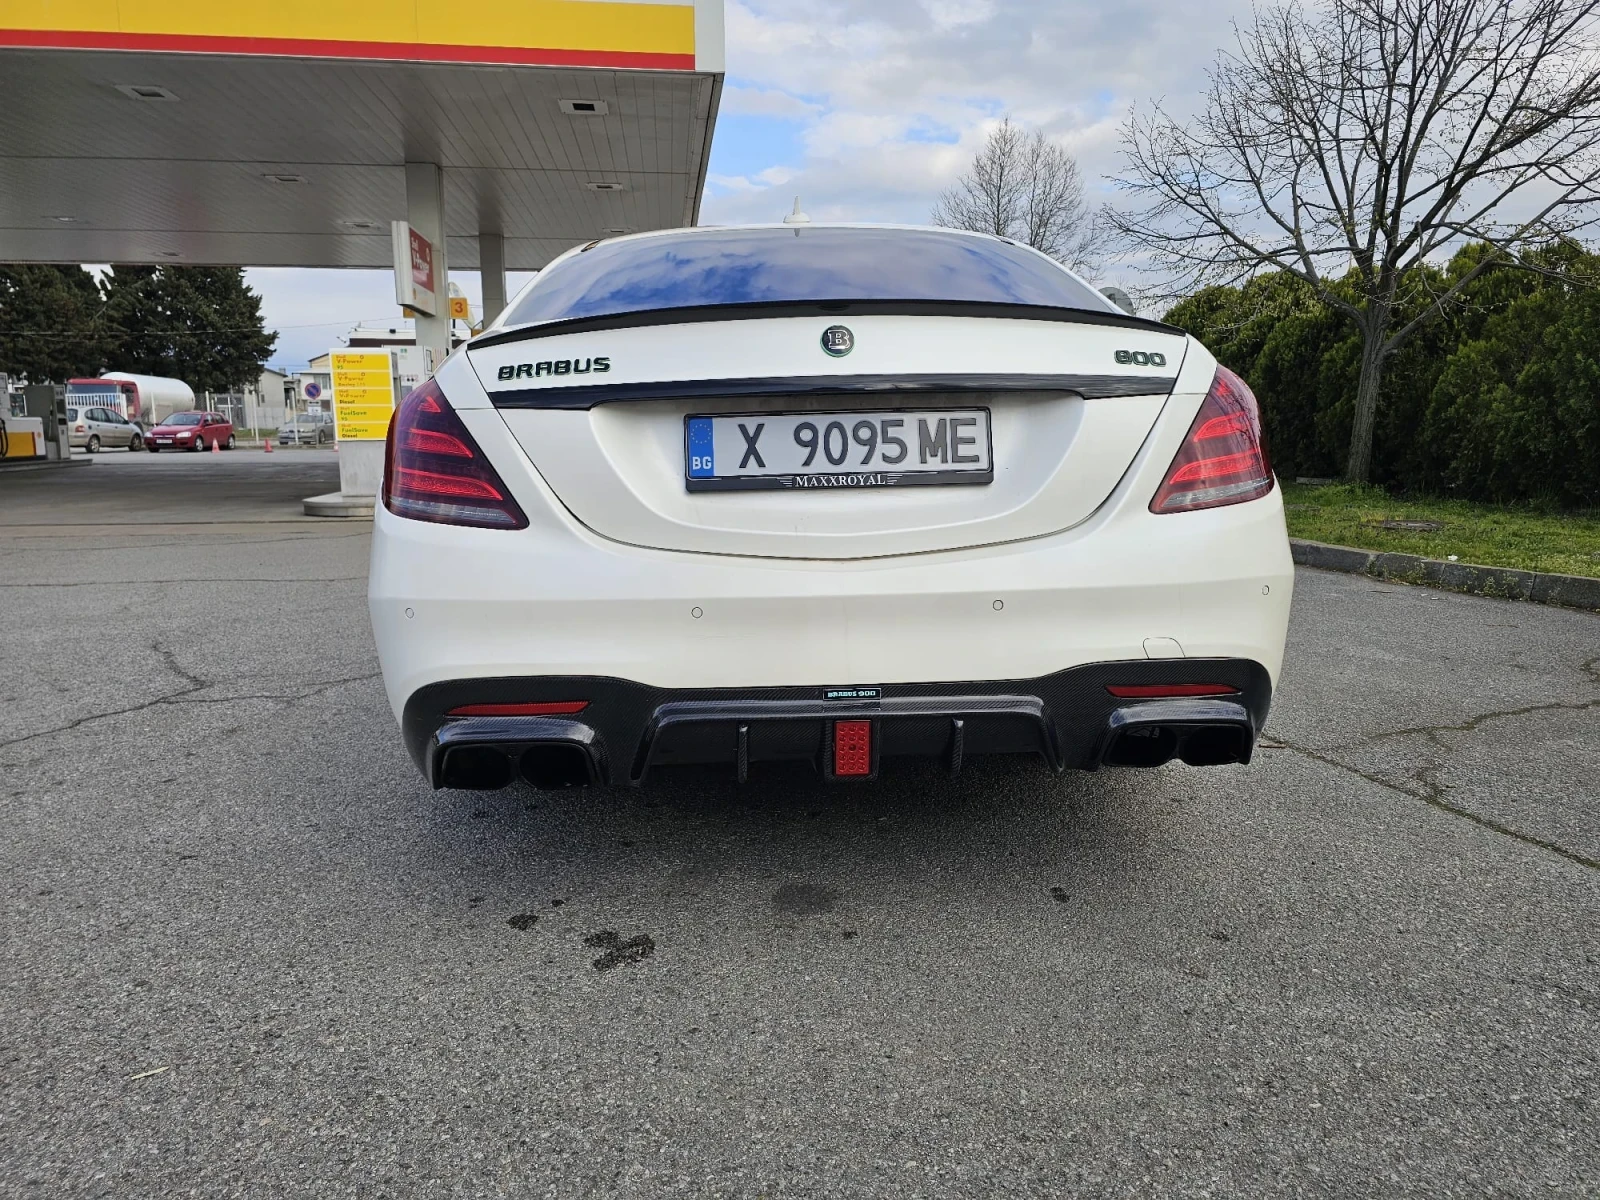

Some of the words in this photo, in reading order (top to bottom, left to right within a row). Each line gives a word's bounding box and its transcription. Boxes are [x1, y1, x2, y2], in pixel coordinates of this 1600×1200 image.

[455, 302, 463, 313] 3
[498, 357, 611, 381] BRABUS
[738, 423, 766, 468] X
[793, 419, 908, 467] 9095
[918, 417, 980, 464] ME
[692, 456, 712, 470] BG
[795, 474, 886, 488] MAXXROYAL
